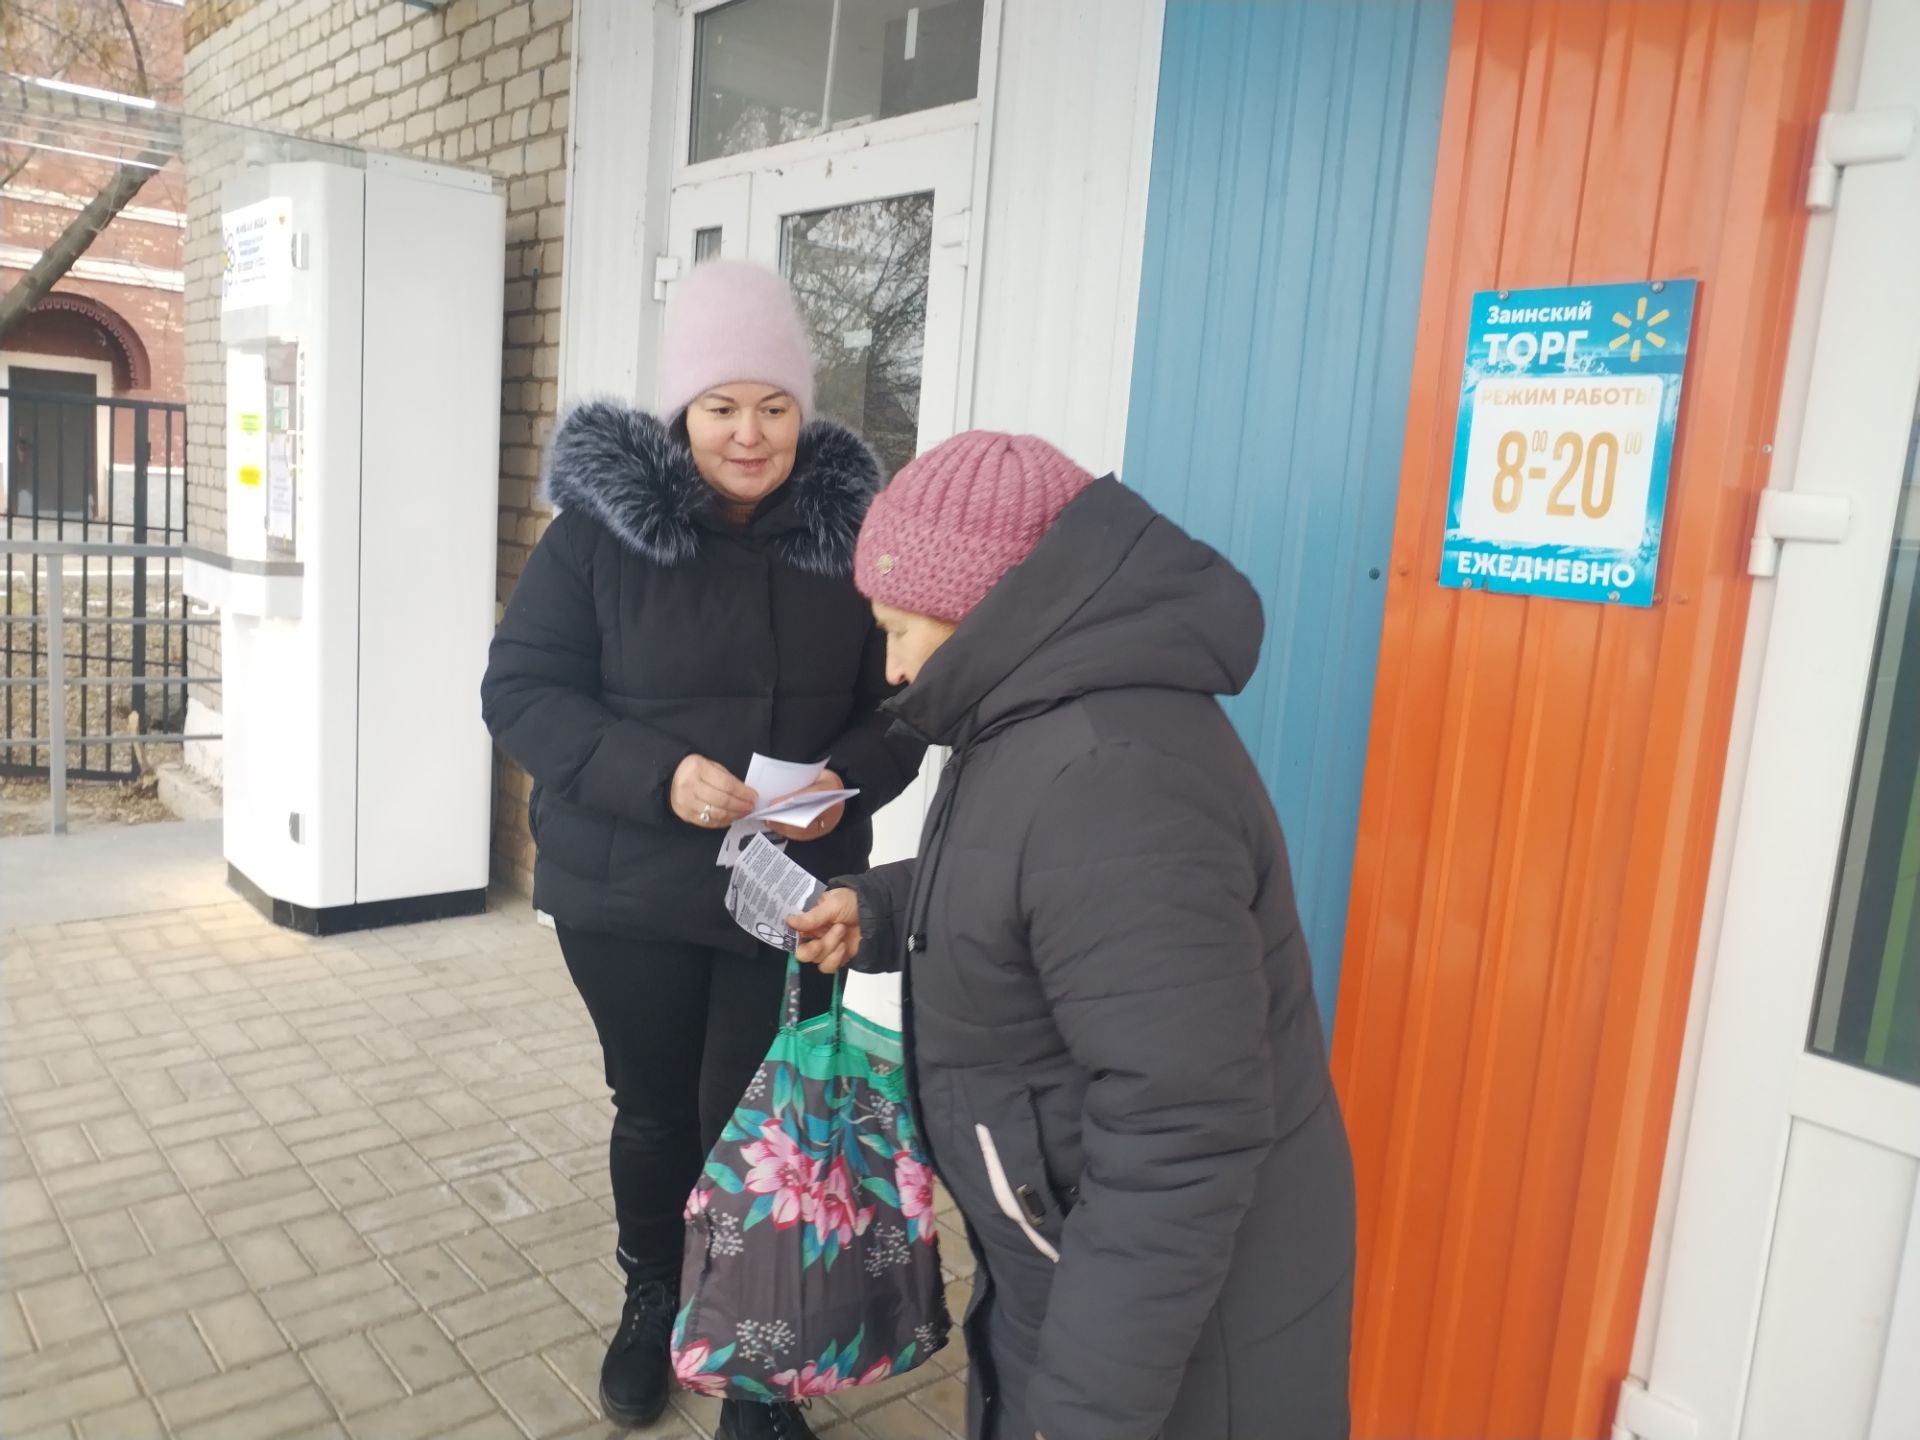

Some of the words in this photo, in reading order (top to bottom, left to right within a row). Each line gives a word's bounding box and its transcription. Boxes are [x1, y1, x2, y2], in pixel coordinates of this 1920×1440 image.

[1486, 300, 1593, 325] Заинский
[1482, 329, 1589, 367] ТОРГ
[1481, 387, 1557, 406] РЕЖИМ
[1457, 551, 1636, 589] ЕЖЕДНЕВНО
